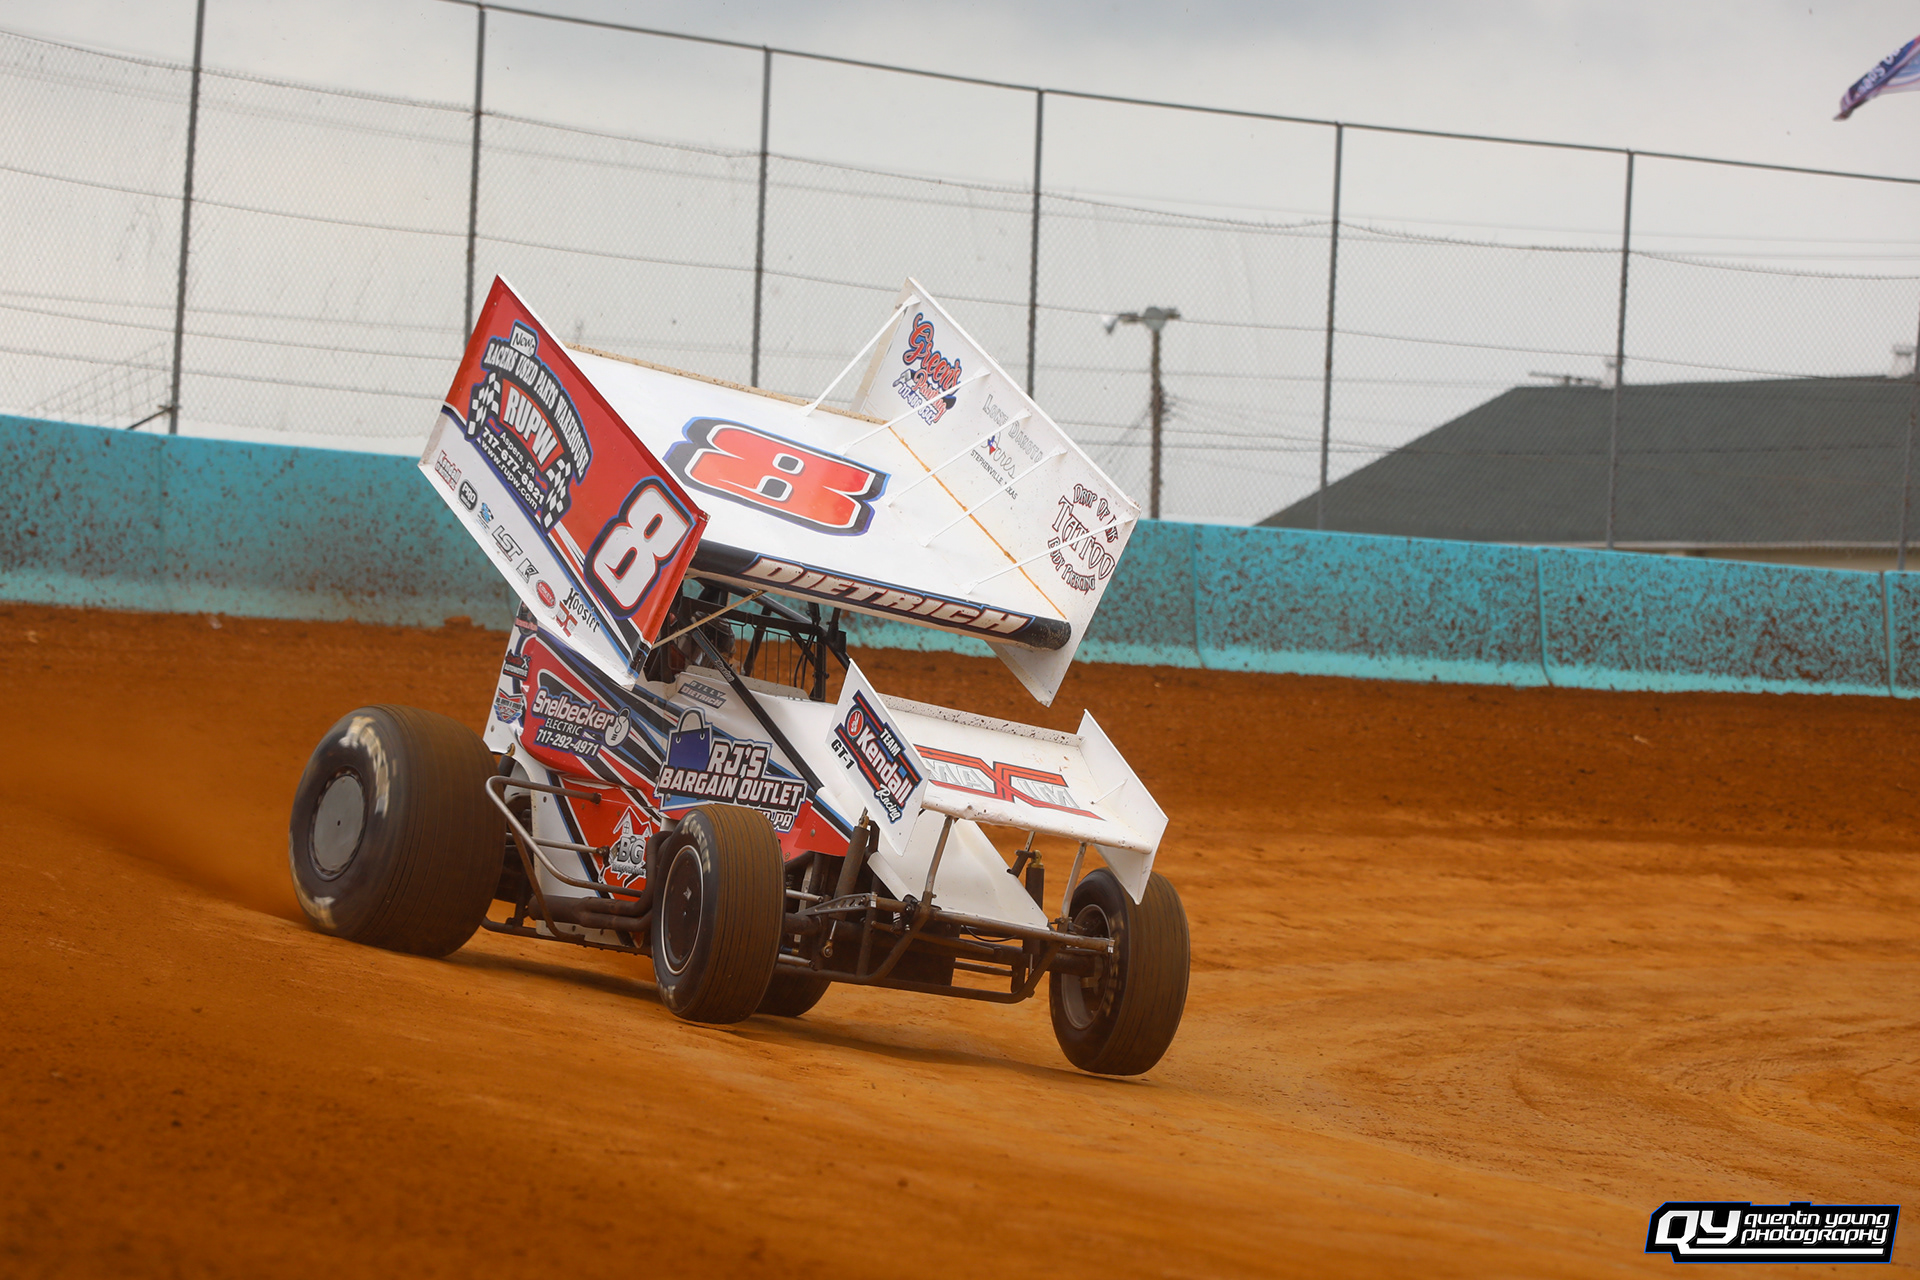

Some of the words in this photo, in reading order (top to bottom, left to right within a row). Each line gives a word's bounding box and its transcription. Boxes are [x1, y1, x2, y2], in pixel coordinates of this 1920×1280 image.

[484, 343, 518, 372] RACERS
[515, 355, 539, 386] USED
[533, 370, 560, 409] PARTS
[554, 395, 590, 478] WAREHOUSE
[912, 369, 947, 423] Paintng
[503, 386, 558, 465] RUPW
[482, 427, 545, 505] 717-677-6821
[500, 432, 525, 465] Aspers,
[526, 461, 536, 477] PA
[461, 481, 477, 504] PRO
[481, 441, 538, 509] www.rupw.com
[684, 424, 876, 528] 8
[1004, 480, 1018, 500] EXAS
[592, 485, 690, 609] 8
[563, 586, 600, 633] Hoosier
[742, 557, 1031, 634] DIETRICH
[531, 688, 615, 730] Snelbecker
[681, 686, 723, 708] DIETRICH
[690, 681, 725, 697] BILLY
[536, 729, 599, 757] 717-292-4971
[545, 719, 583, 736] ELECTRIC
[880, 728, 901, 757] TEAM
[707, 744, 765, 778] RJ'S
[831, 739, 855, 770] GT-1
[857, 725, 913, 807] Kendall
[659, 768, 737, 798] BARGAIN
[738, 780, 803, 807] OUTLET
[876, 784, 901, 821] Racing
[773, 812, 793, 828] PA
